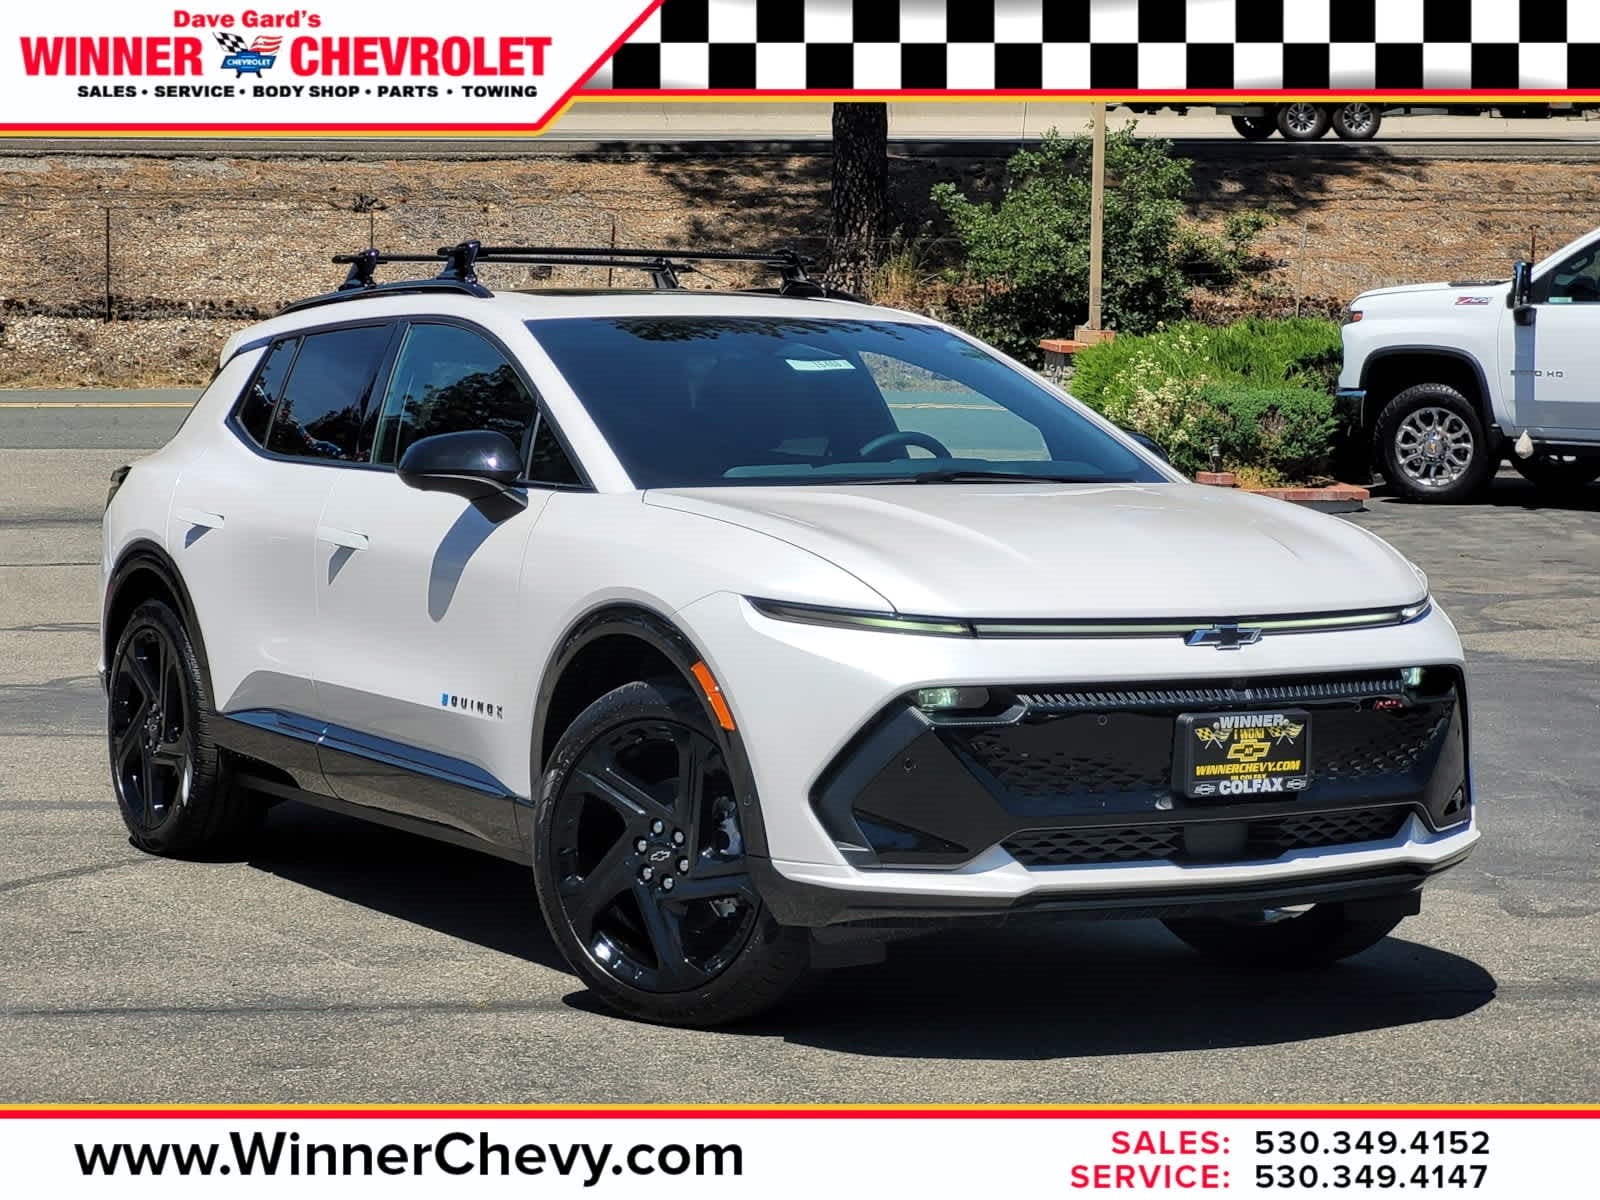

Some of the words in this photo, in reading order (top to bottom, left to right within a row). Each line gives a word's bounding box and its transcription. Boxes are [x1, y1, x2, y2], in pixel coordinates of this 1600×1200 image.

[1219, 714, 1284, 728] WINNER
[1196, 760, 1301, 776] WINNERCHEVY.COM
[1219, 778, 1284, 796] COLFAX
